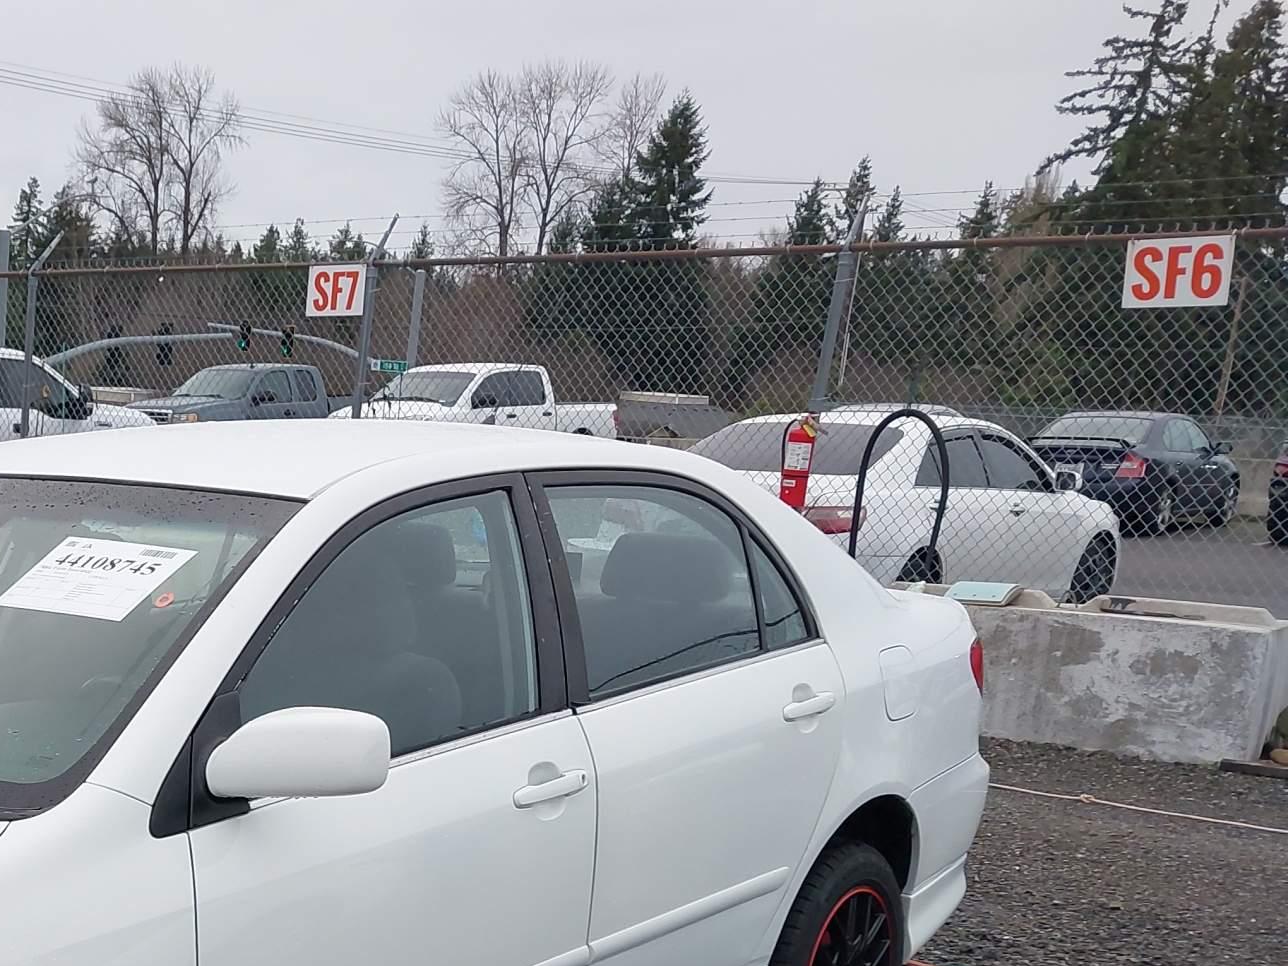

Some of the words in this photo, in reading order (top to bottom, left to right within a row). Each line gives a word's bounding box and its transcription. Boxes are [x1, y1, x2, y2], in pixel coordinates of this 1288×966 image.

[313, 271, 360, 312] SF7
[1131, 243, 1224, 301] SF6
[55, 552, 163, 576] 44108745
